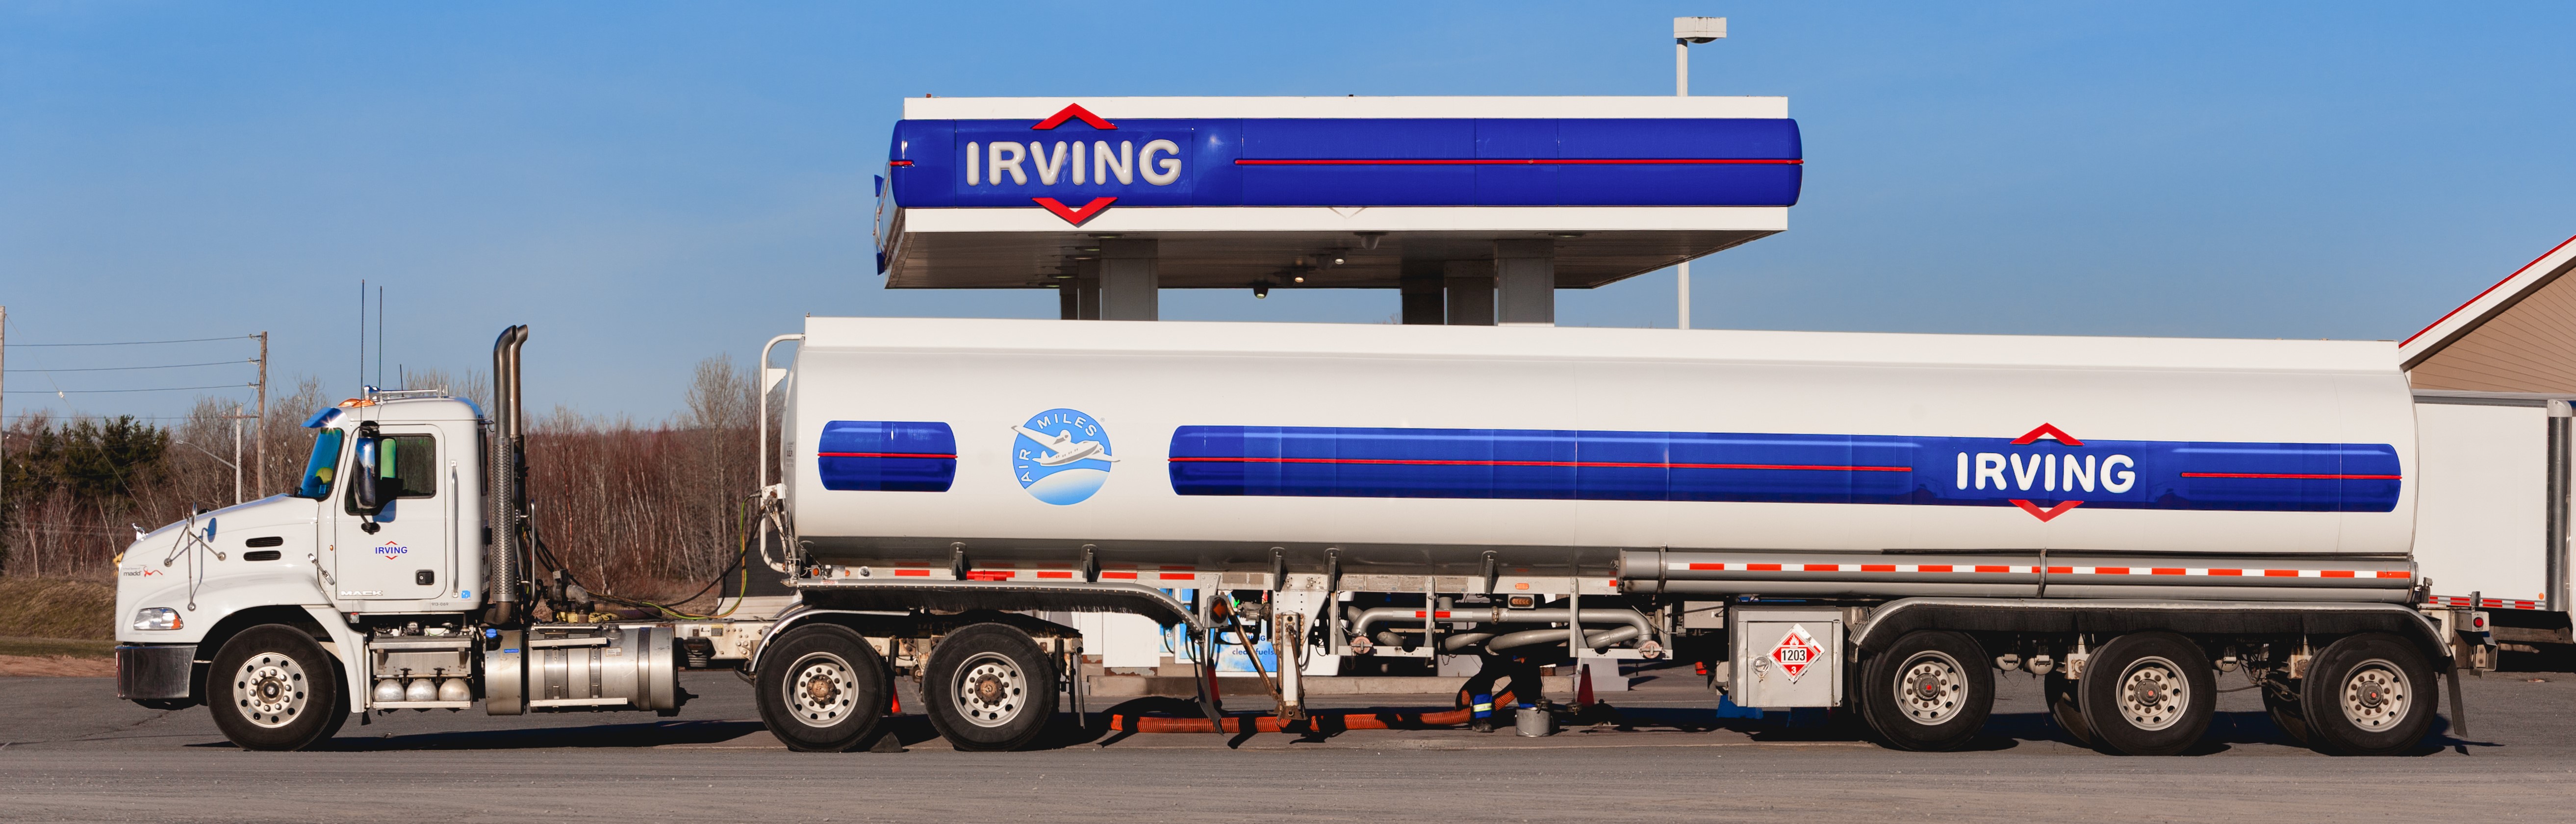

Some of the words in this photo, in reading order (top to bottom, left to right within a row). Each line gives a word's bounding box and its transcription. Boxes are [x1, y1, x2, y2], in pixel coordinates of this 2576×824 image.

[967, 139, 1181, 186] IRVING
[1018, 449, 1033, 482] AIR
[1037, 414, 1097, 436] MILES
[1957, 452, 2135, 494] IRVING
[1782, 650, 1805, 661] 1203
